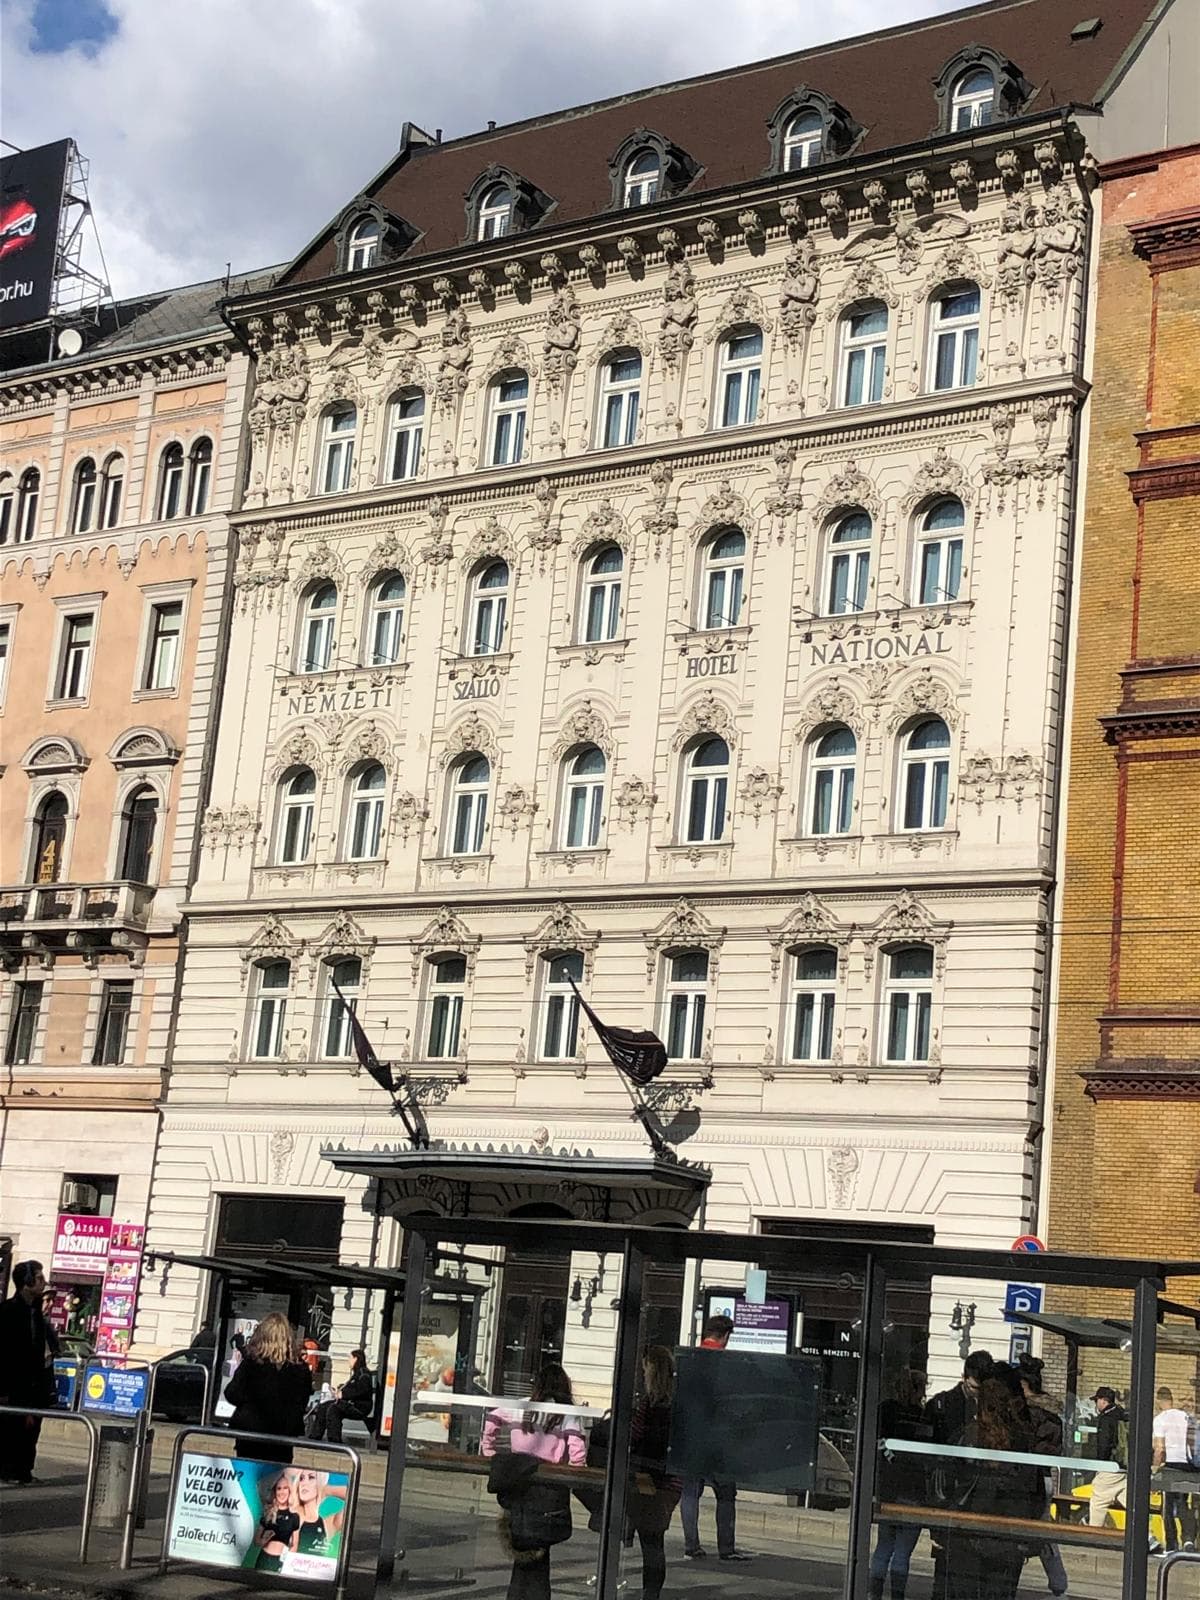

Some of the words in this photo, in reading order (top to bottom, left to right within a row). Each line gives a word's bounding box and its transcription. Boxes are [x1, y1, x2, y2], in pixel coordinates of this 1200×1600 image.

[810, 632, 952, 666] NATIONAL
[686, 654, 738, 678] HOTEL
[288, 688, 393, 715] NEMZETI
[76, 1223, 104, 1233] ÁZSIA
[57, 1234, 109, 1254] DISZKONT
[841, 1331, 850, 1342] N
[823, 1349, 850, 1357] NEMZETI
[188, 1464, 244, 1481] VITAMIN?
[186, 1478, 223, 1493] VELED
[183, 1492, 240, 1510] VAGYUNK
